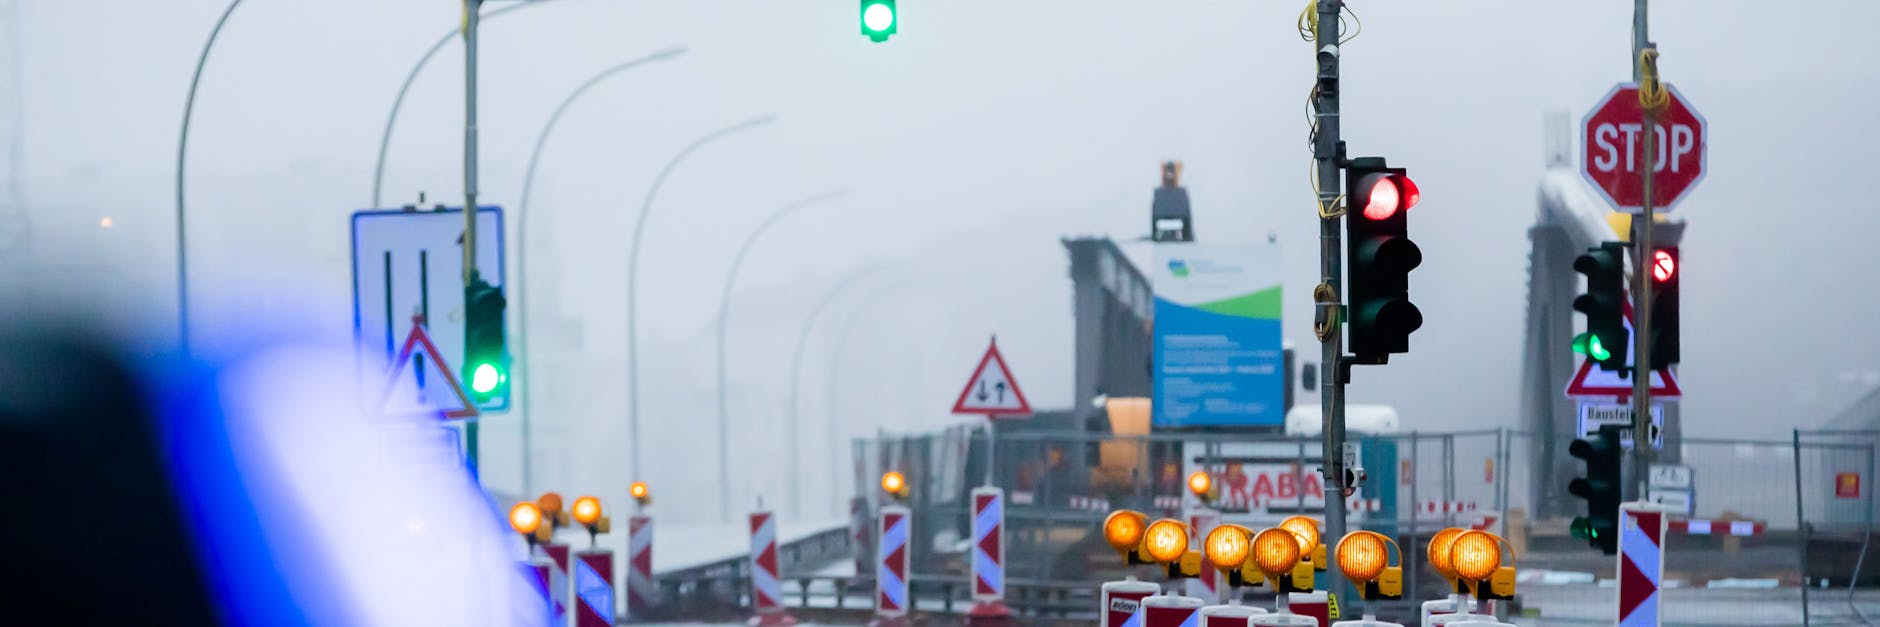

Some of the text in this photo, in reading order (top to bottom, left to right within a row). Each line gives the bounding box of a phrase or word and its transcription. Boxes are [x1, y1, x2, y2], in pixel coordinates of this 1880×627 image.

[1594, 122, 1694, 172] STOP
[1587, 407, 1630, 420] Baustel
[1210, 472, 1323, 499] TRABA
